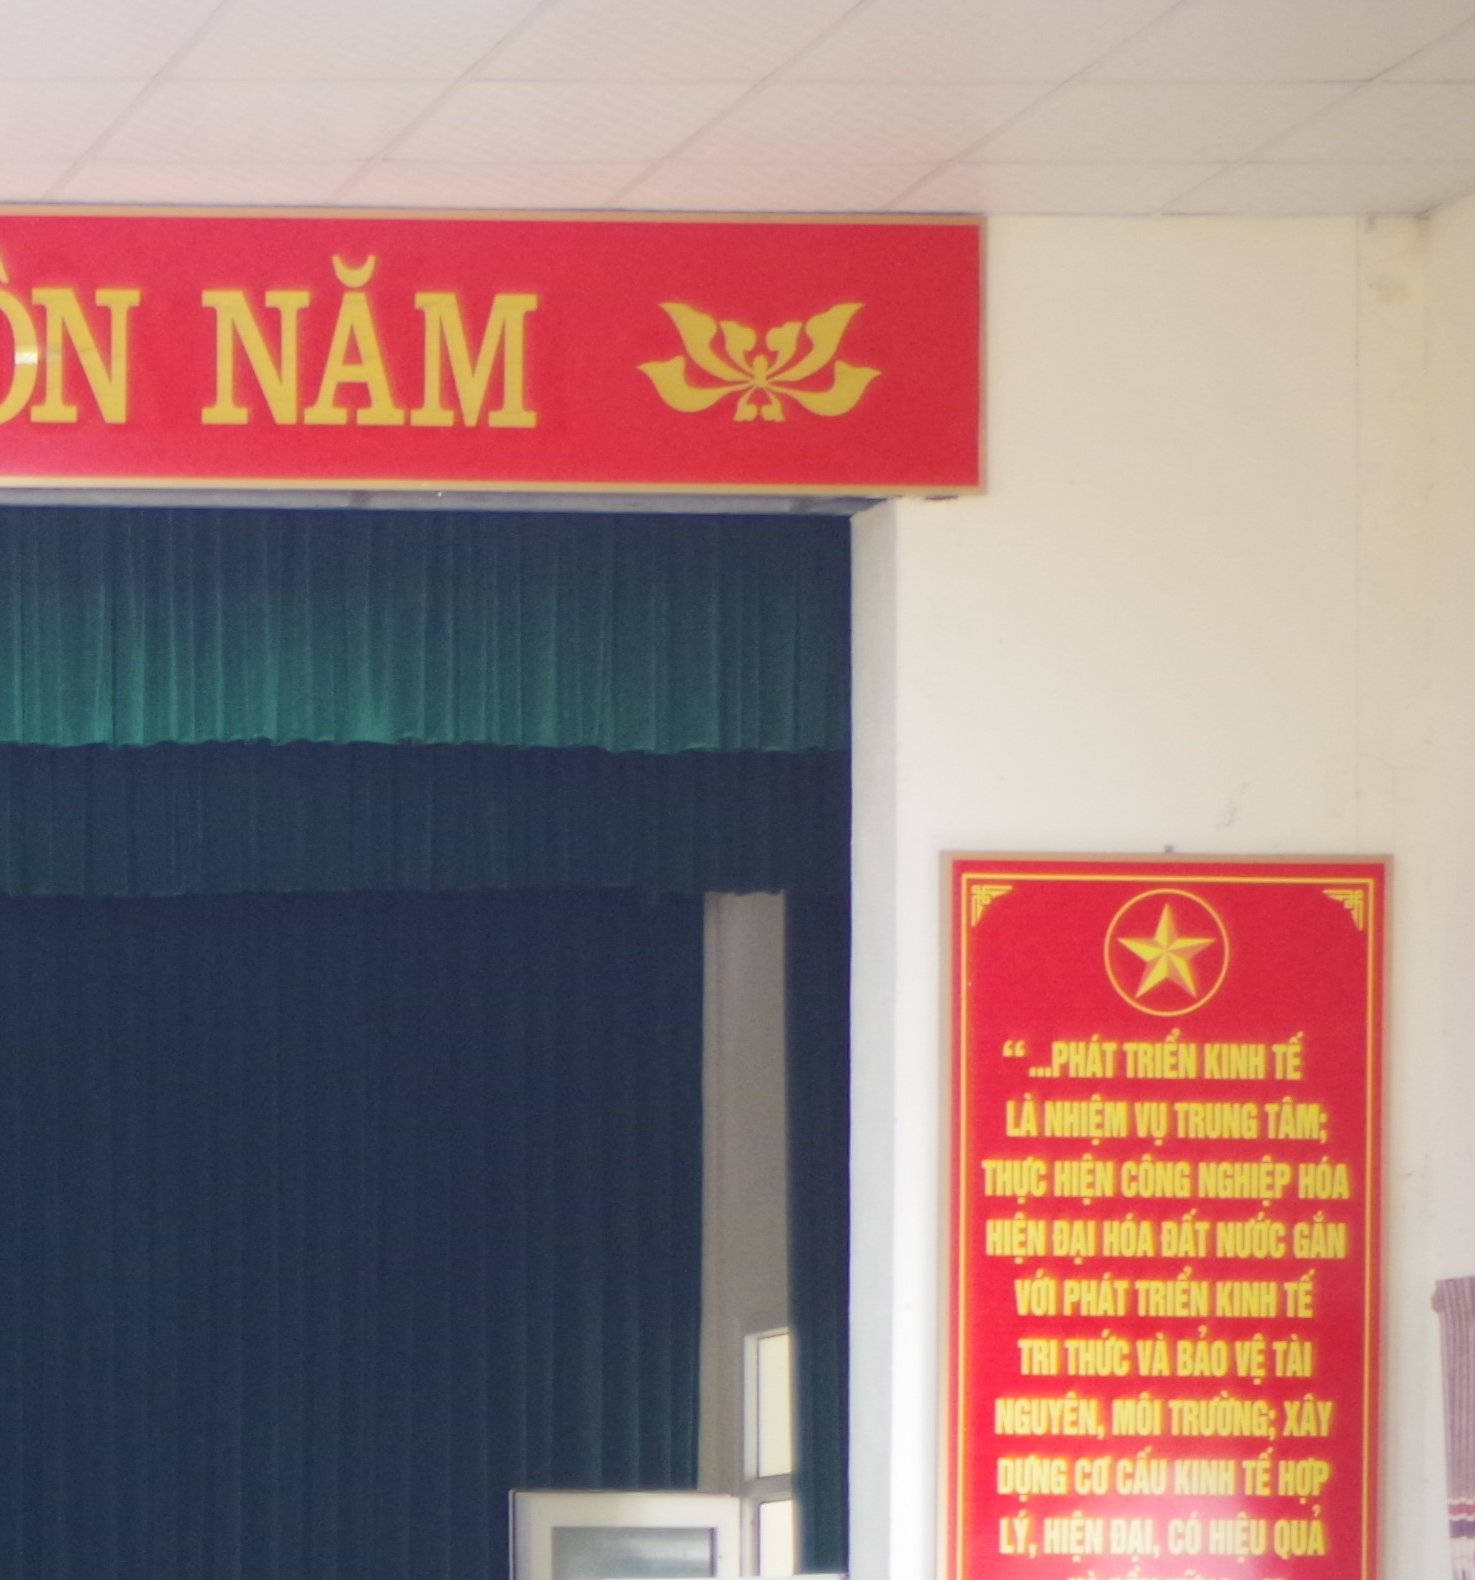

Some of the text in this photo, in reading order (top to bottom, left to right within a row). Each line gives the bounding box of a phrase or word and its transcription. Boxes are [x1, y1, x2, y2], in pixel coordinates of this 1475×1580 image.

[200, 254, 538, 429] NĂM
[1123, 1028, 1197, 1079] TRIỂN
[1204, 1043, 1265, 1080] KINH
[1272, 1031, 1304, 1080] TẾ
[1006, 1092, 1328, 1146] LÀ NHIỆM VỤ TRUNG TÂM;
[981, 1152, 1350, 1207] THỰC HIỆN CÔNG NGHIỆP HÓA
[986, 1208, 1347, 1265] HIỆN ĐẠI HÓA ĐẤT NƯỚC GẮN
[1014, 1265, 1315, 1318] VỚI PHÁT TRIỂN KINH TẾ
[1018, 1325, 1312, 1385] TRI THỨC VÀ BẢO VỆ TÀI
[995, 1390, 1333, 1441] NGUYÊN, MÔI TRƯỜNG; XÂY
[997, 1446, 1330, 1505] DỰNG CƠ CẤU KINH TẾ HỢP
[999, 1504, 1326, 1563] LÝ, HIỆN ĐẠI, CÓ HIỆU QUẢ
